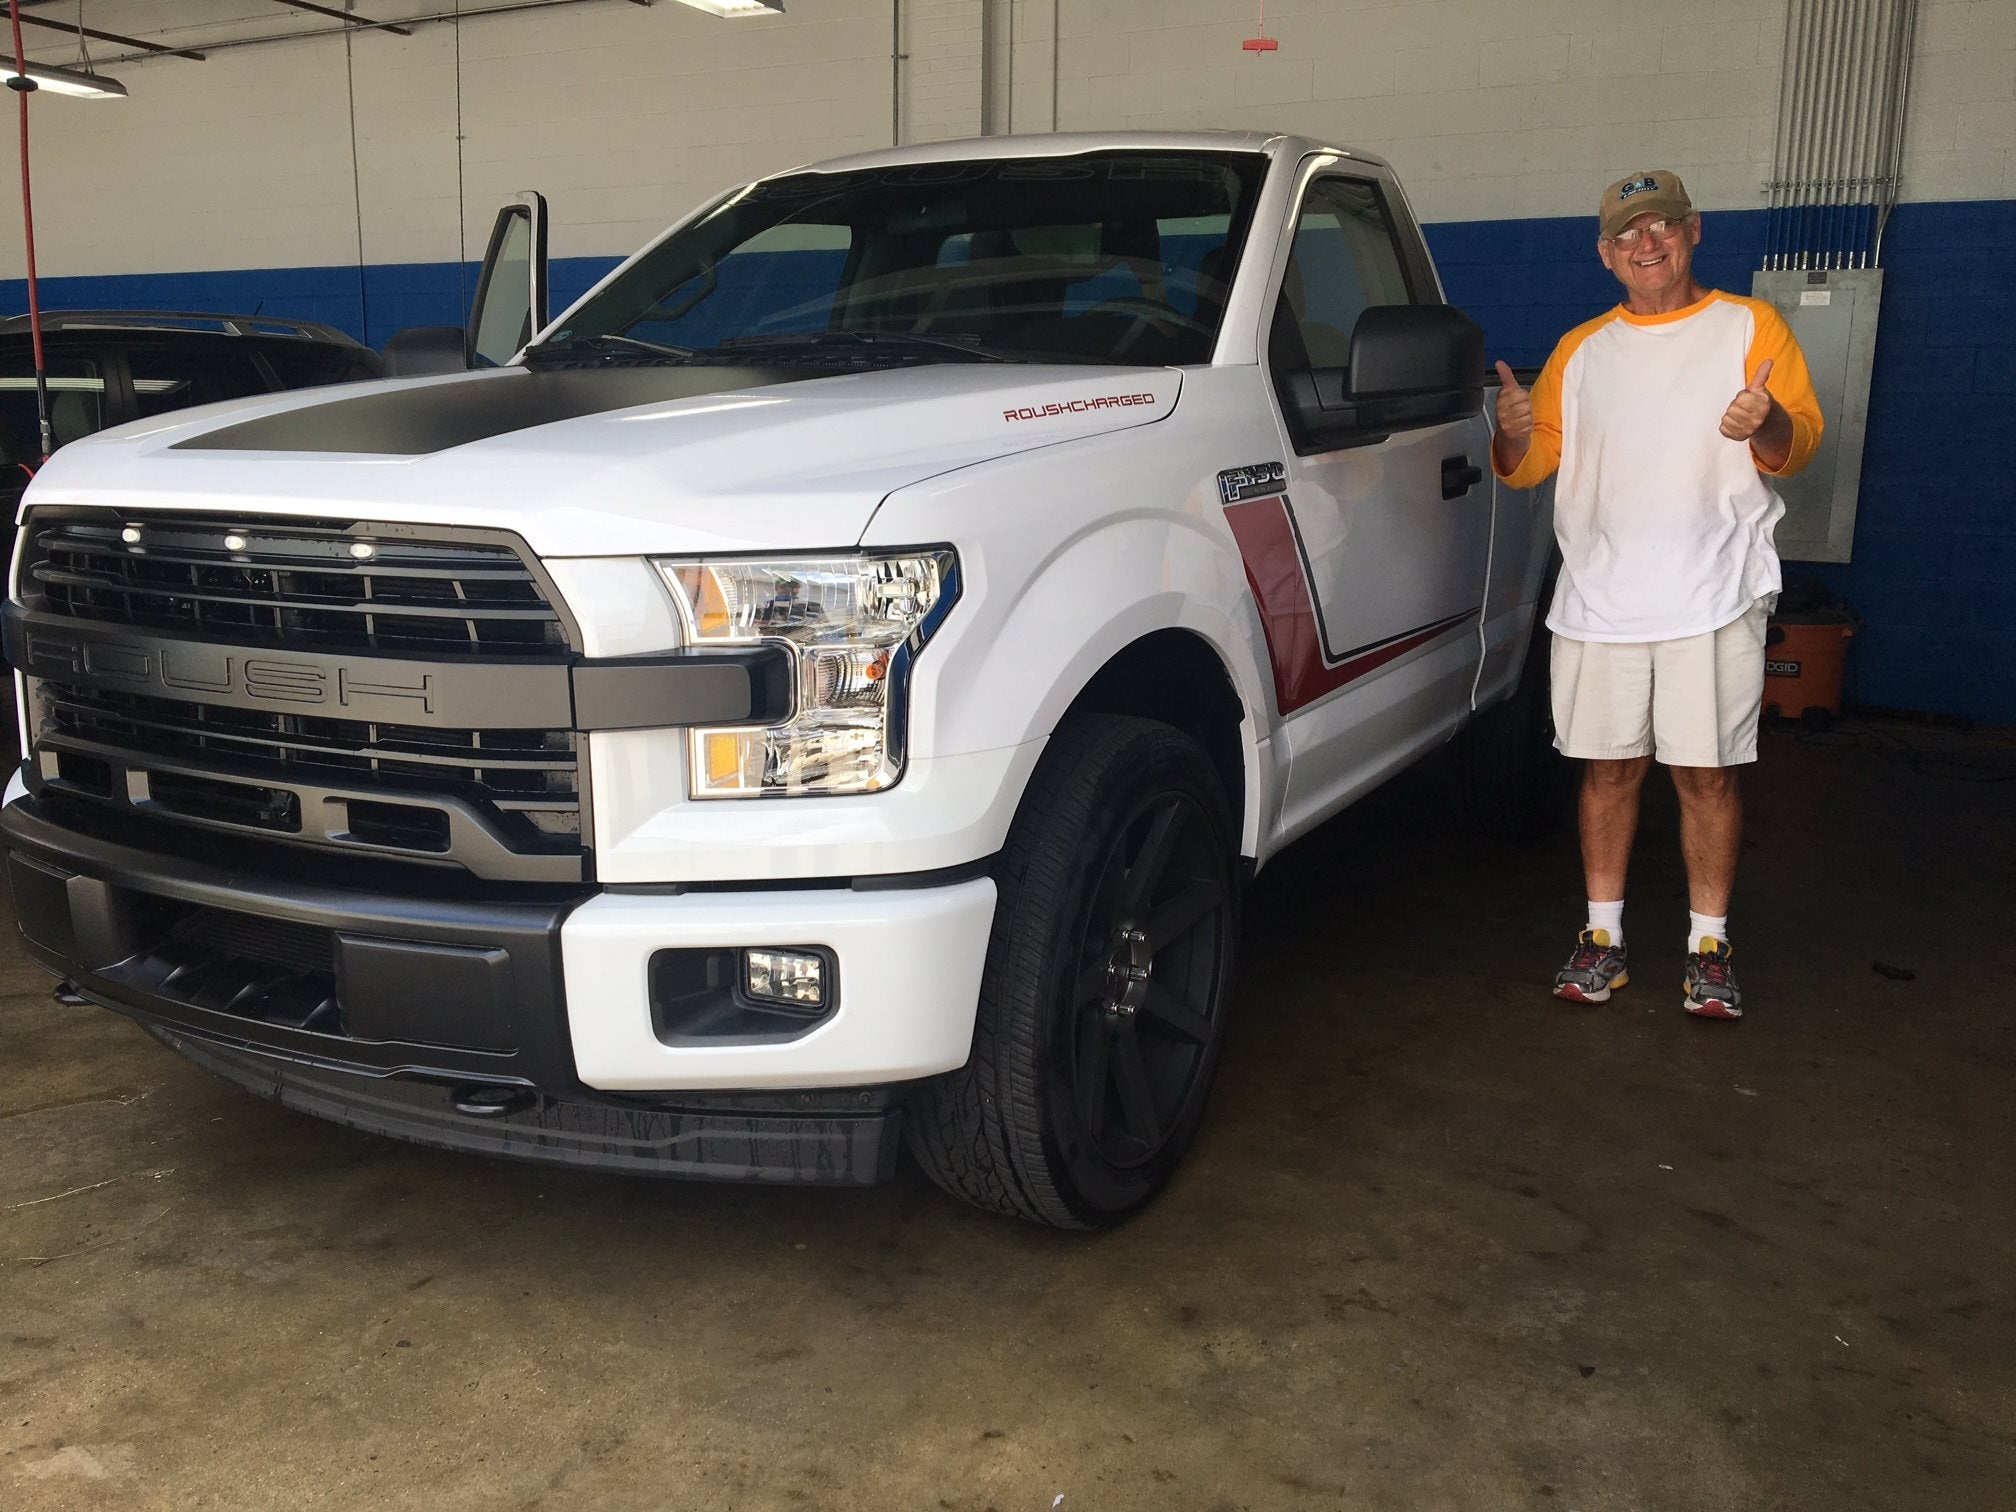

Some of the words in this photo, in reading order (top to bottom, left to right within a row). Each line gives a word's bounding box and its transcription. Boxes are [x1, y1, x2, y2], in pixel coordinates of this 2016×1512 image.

[1003, 393, 1155, 422] ROUSHCHARGED
[26, 631, 435, 714] ROUSH
[1766, 661, 1799, 672] DGID
